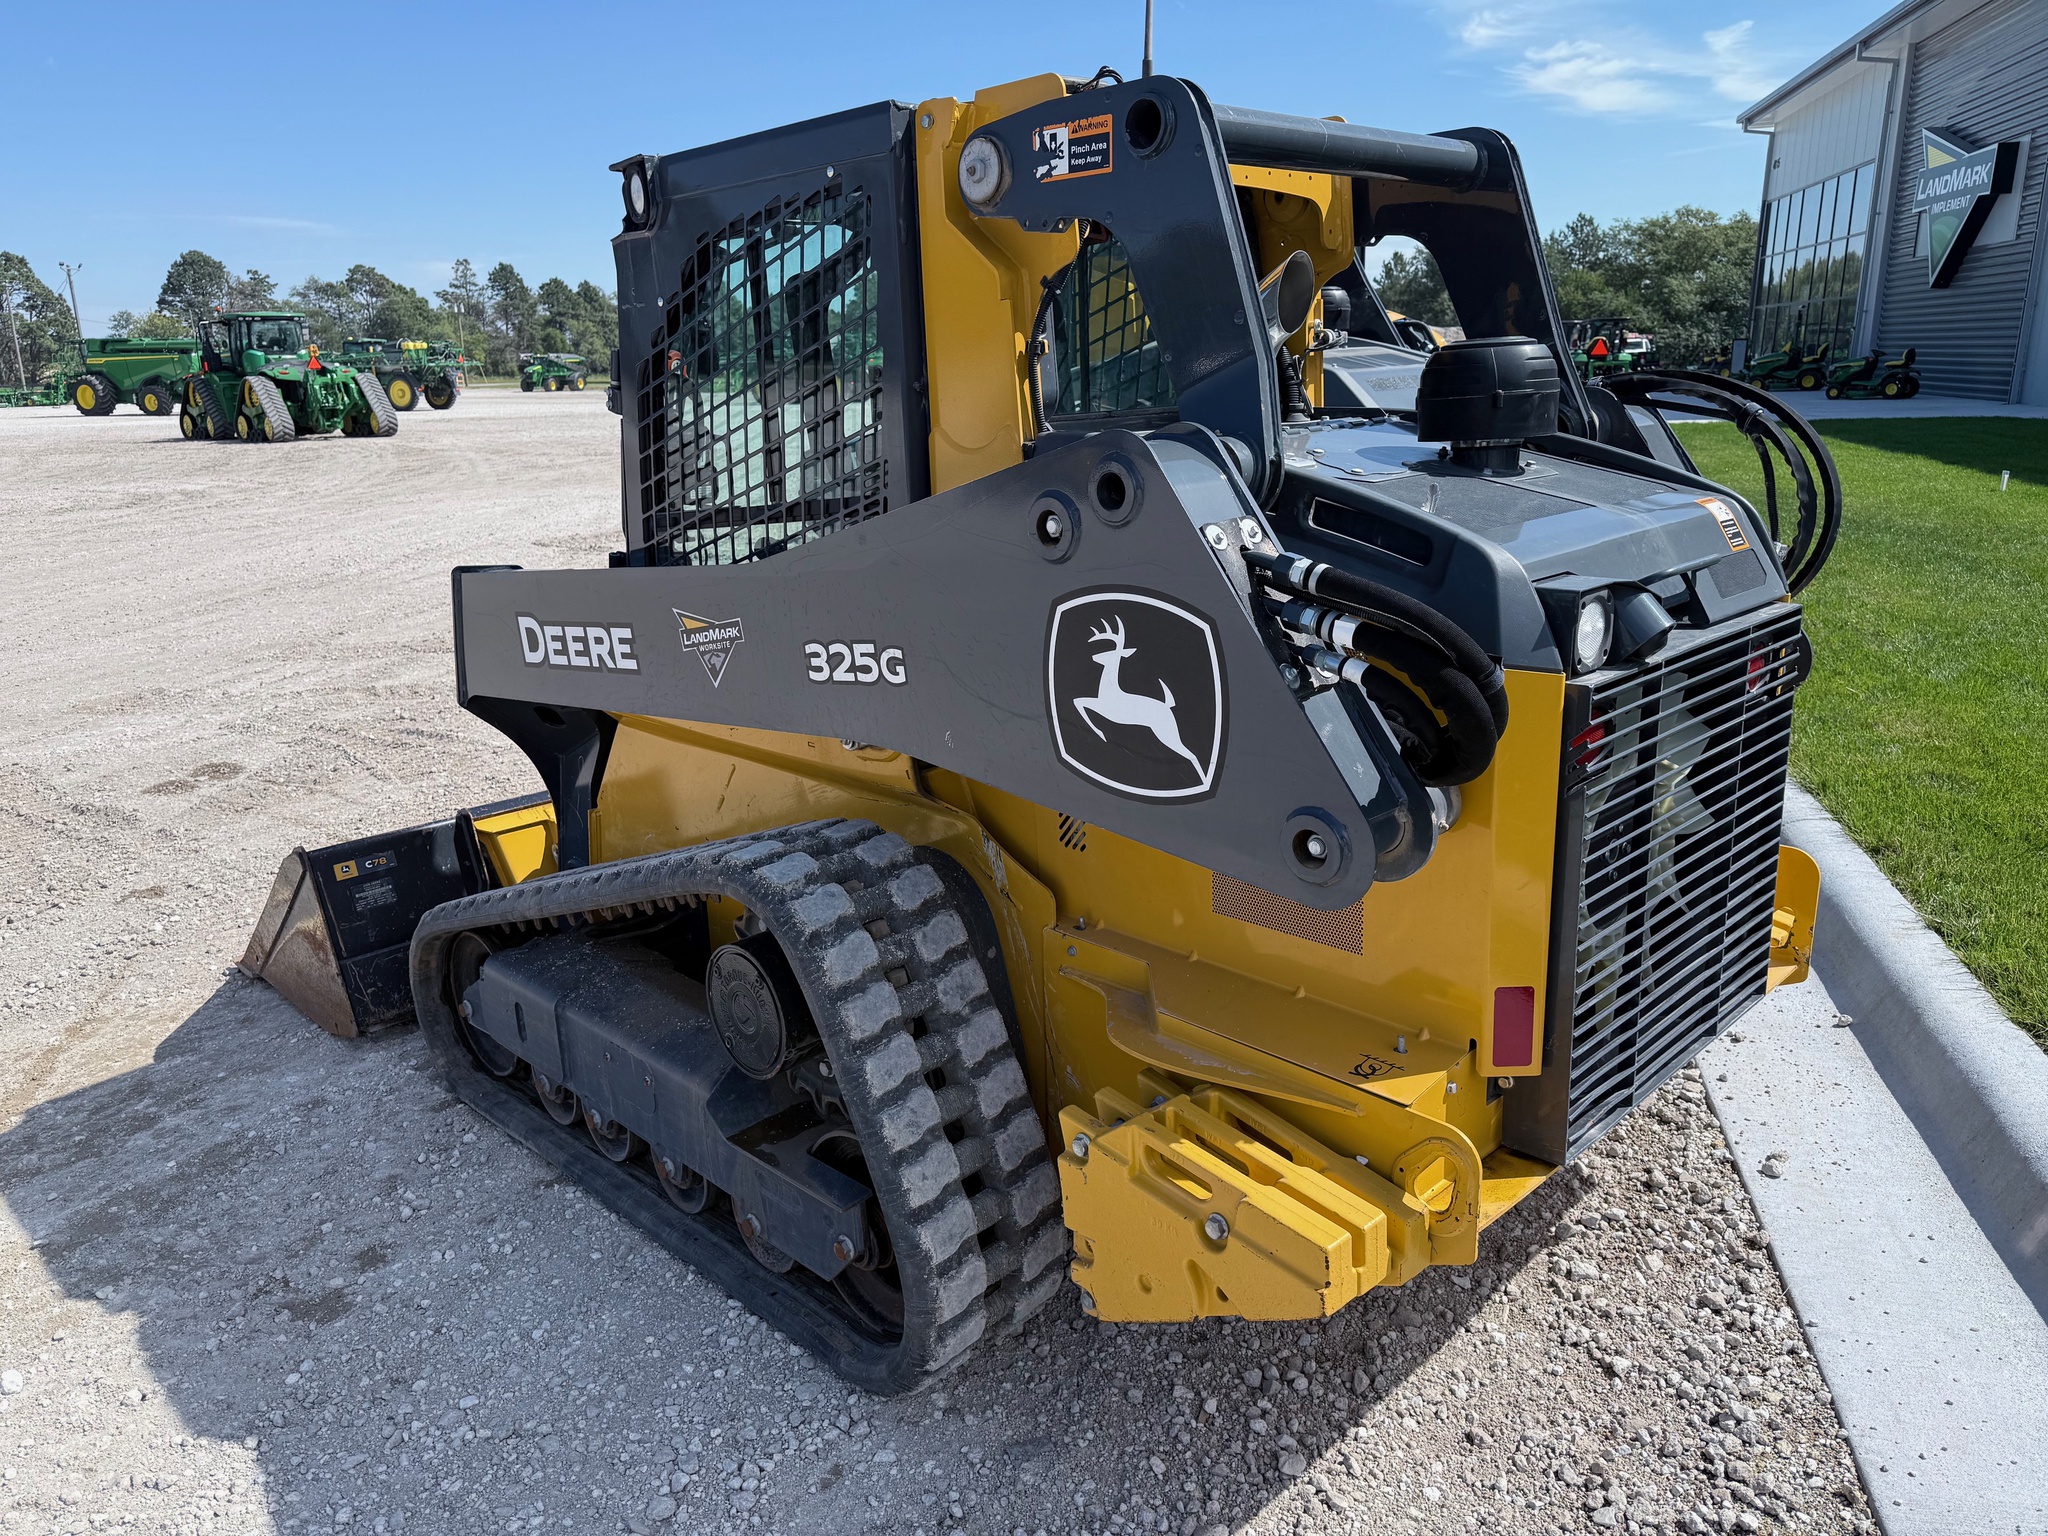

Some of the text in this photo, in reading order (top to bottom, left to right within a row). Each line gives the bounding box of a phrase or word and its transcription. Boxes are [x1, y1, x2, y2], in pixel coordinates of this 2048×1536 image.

[1078, 120, 1108, 132] WARNING
[1070, 141, 1107, 154] Pinch Area
[1070, 155, 1102, 166] Keep Away
[1916, 162, 1992, 201] LANDMARK
[1930, 195, 1971, 215] IMPLEMENT
[683, 626, 740, 644] LANDMARK
[518, 616, 639, 671] DEERE
[699, 641, 731, 652] WORKSITE
[804, 644, 907, 684] 325G
[365, 857, 387, 868] C78
